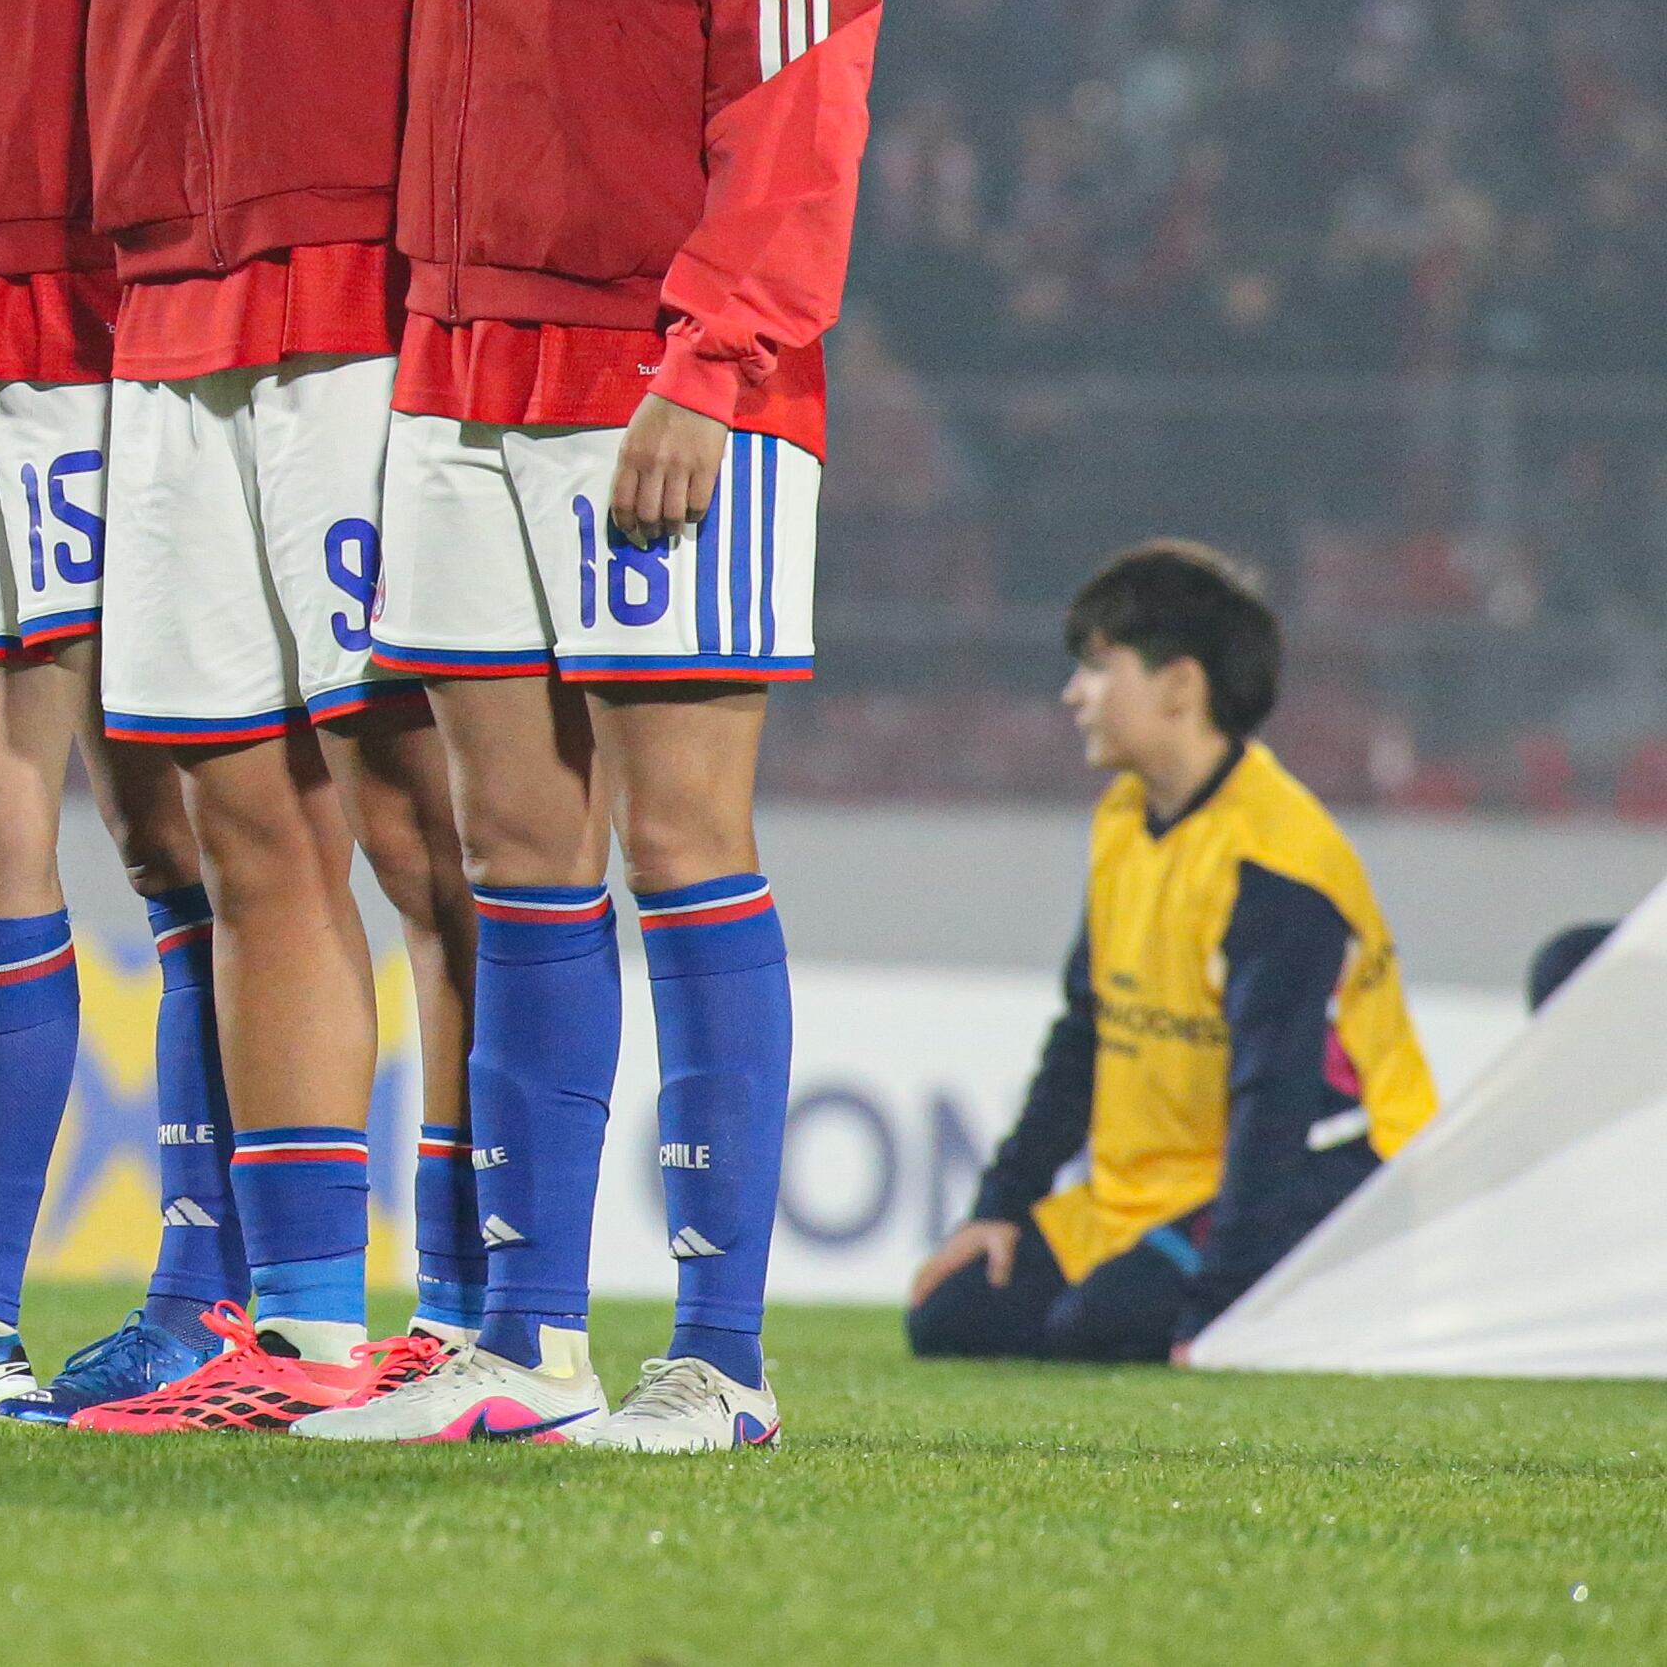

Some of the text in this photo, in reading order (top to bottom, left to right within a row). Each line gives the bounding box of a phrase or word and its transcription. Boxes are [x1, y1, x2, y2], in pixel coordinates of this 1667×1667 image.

[21, 450, 105, 593] 15
[324, 518, 380, 652] 9
[659, 1142, 710, 1169] CHILE
